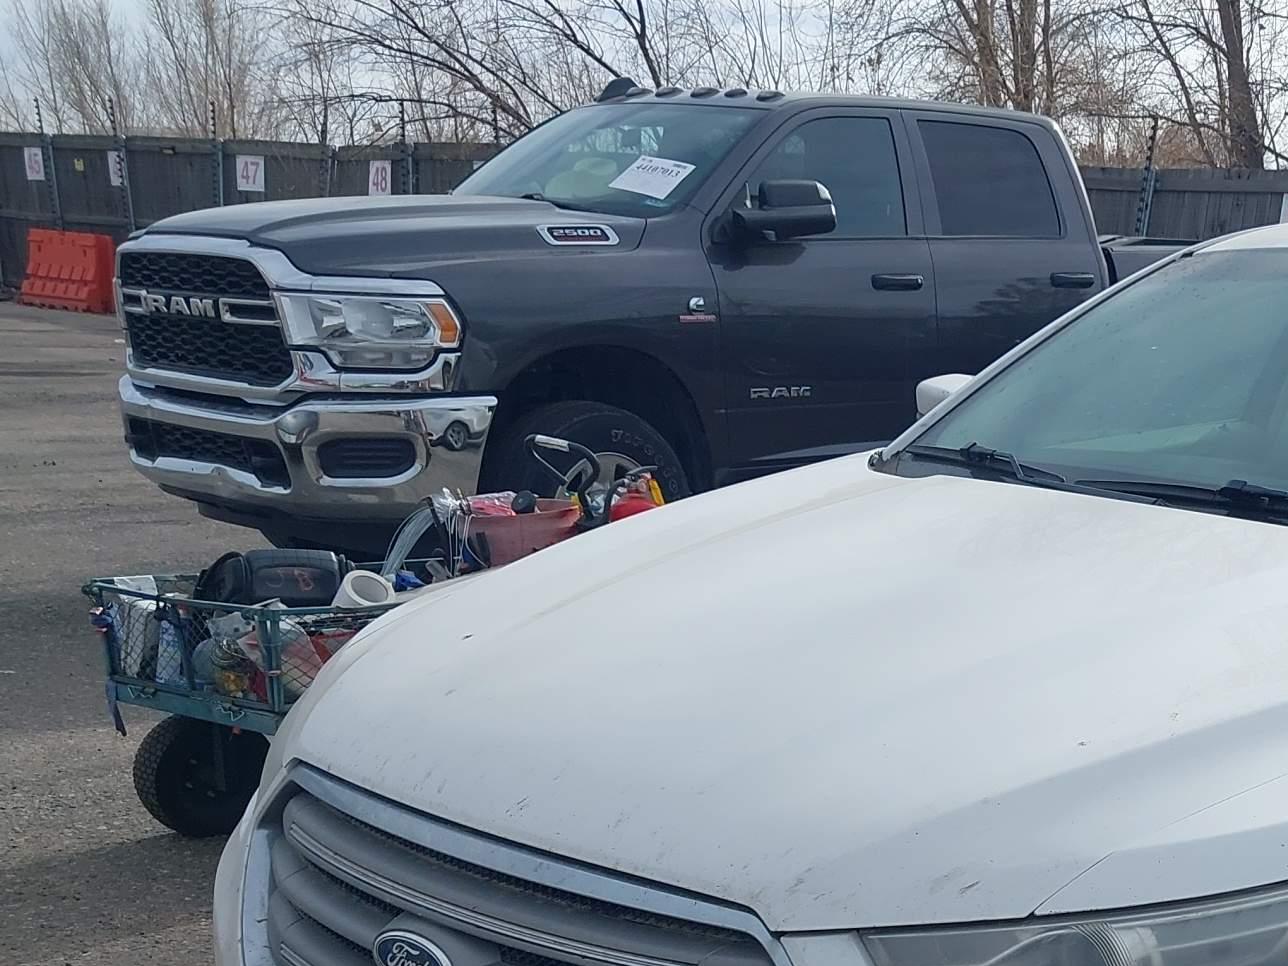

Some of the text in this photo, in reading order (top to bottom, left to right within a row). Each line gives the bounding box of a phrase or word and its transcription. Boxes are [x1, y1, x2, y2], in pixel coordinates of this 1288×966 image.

[240, 161, 260, 185] 47
[372, 165, 388, 192] 48
[143, 294, 215, 317] RAM
[750, 386, 811, 399] RAM
